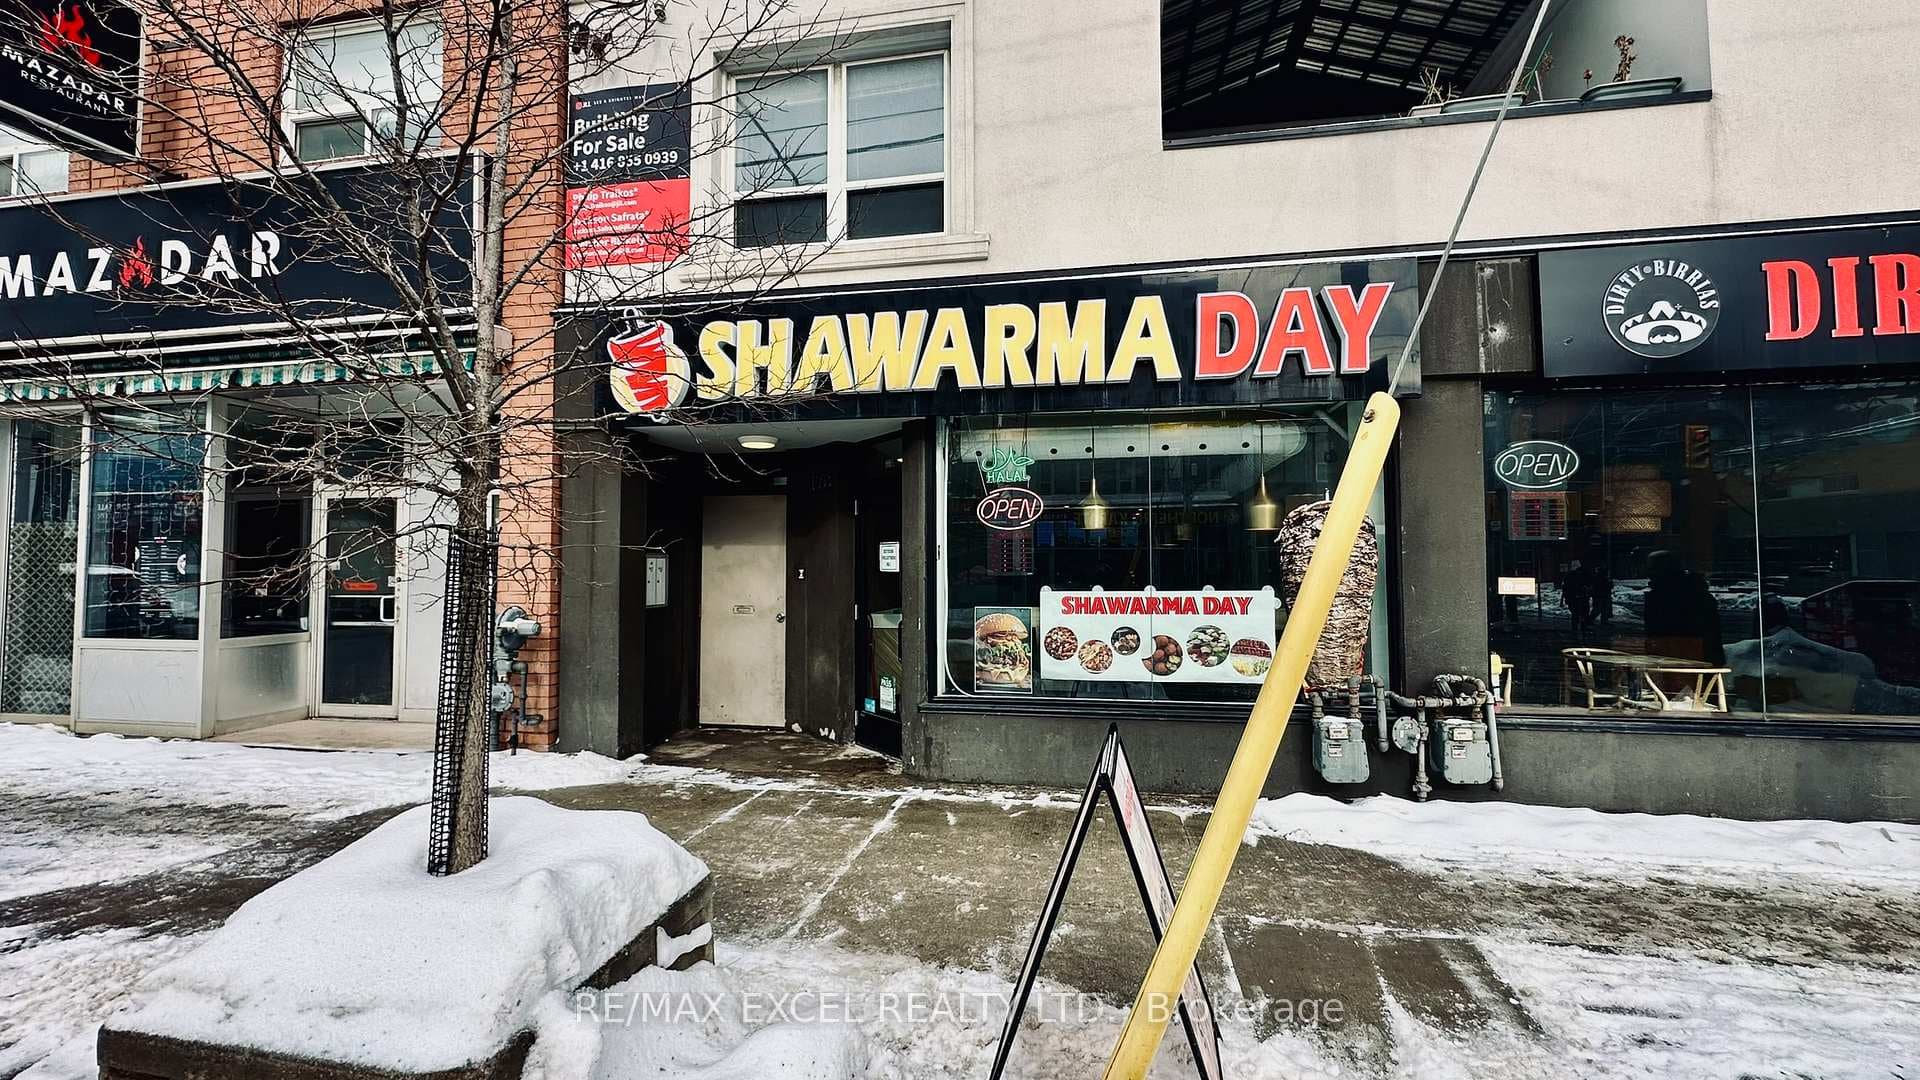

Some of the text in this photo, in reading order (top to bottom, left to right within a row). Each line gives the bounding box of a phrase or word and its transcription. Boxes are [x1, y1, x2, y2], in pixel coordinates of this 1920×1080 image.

[1, 45, 126, 112] MAZADAR
[20, 70, 109, 116] RESTAURANT
[573, 132, 646, 157] For Sale
[590, 156, 614, 171] 416
[644, 150, 679, 165] 0939
[0, 230, 281, 299] MAZADAR
[1605, 259, 1720, 315] DIRTY BIRRIAS
[696, 281, 1395, 400] SHAWARMA DAY
[986, 469, 1030, 483] HALAL
[1500, 453, 1571, 476] OPEN
[980, 498, 1037, 520] OPEN
[1060, 596, 1254, 616] SHAWARMA DAY
